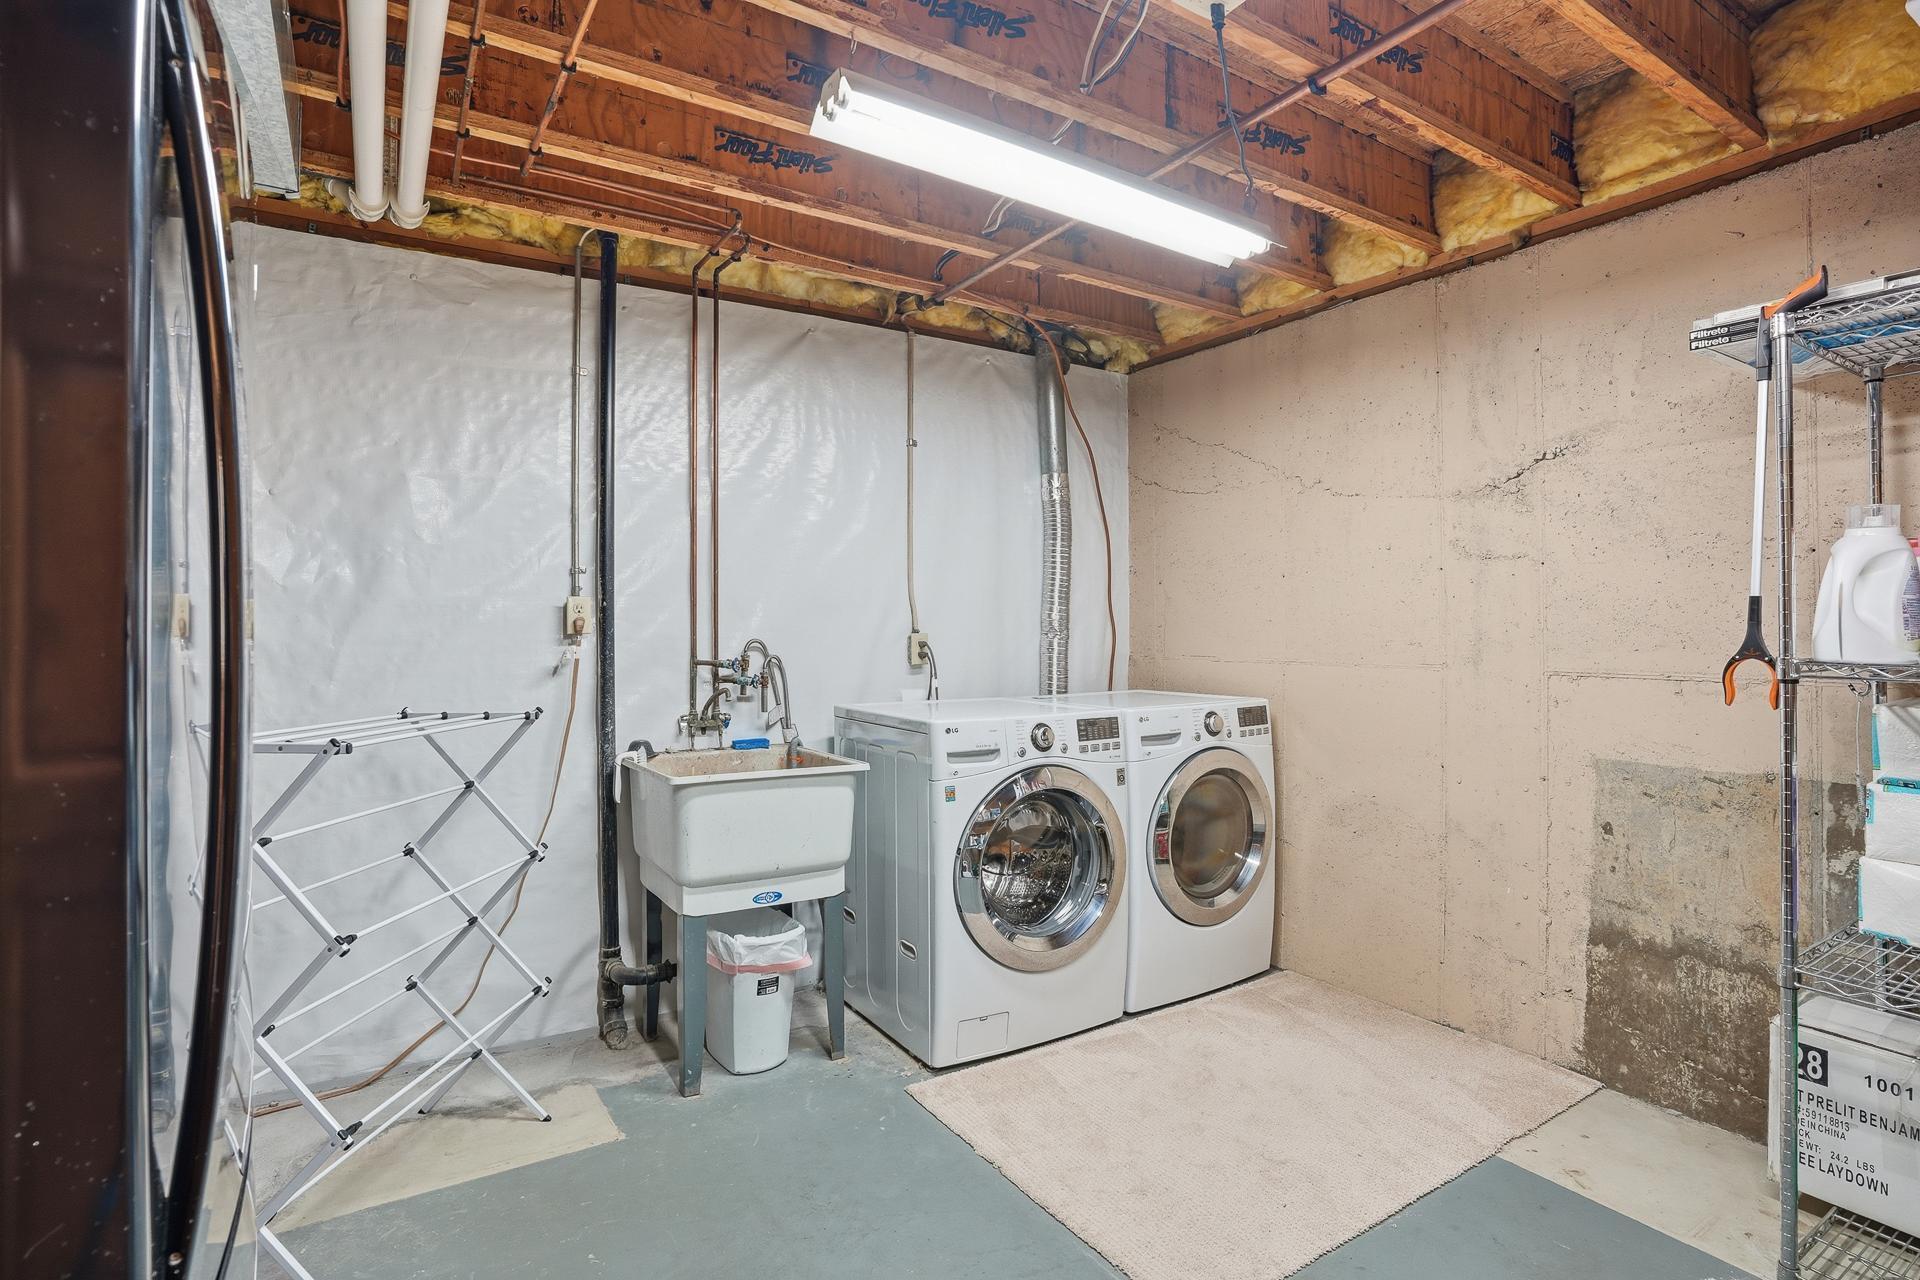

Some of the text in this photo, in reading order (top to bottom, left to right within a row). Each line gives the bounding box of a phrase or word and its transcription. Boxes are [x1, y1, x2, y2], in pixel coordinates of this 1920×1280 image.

[771, 148, 841, 175] Silent
[1690, 326, 1729, 340] Filtrete
[1690, 336, 1730, 350] Filtrete
[1864, 1074, 1914, 1101] 1001
[1807, 1092, 1855, 1119] PRELIT
[1859, 1109, 1920, 1142] BENJAM
[1818, 1123, 1847, 1141] CHINA
[1806, 1141, 1821, 1154] WT:
[1830, 1151, 1849, 1165] 24.2
[1856, 1159, 1875, 1173] LBS
[1818, 1158, 1889, 1196] LAYDOWN
